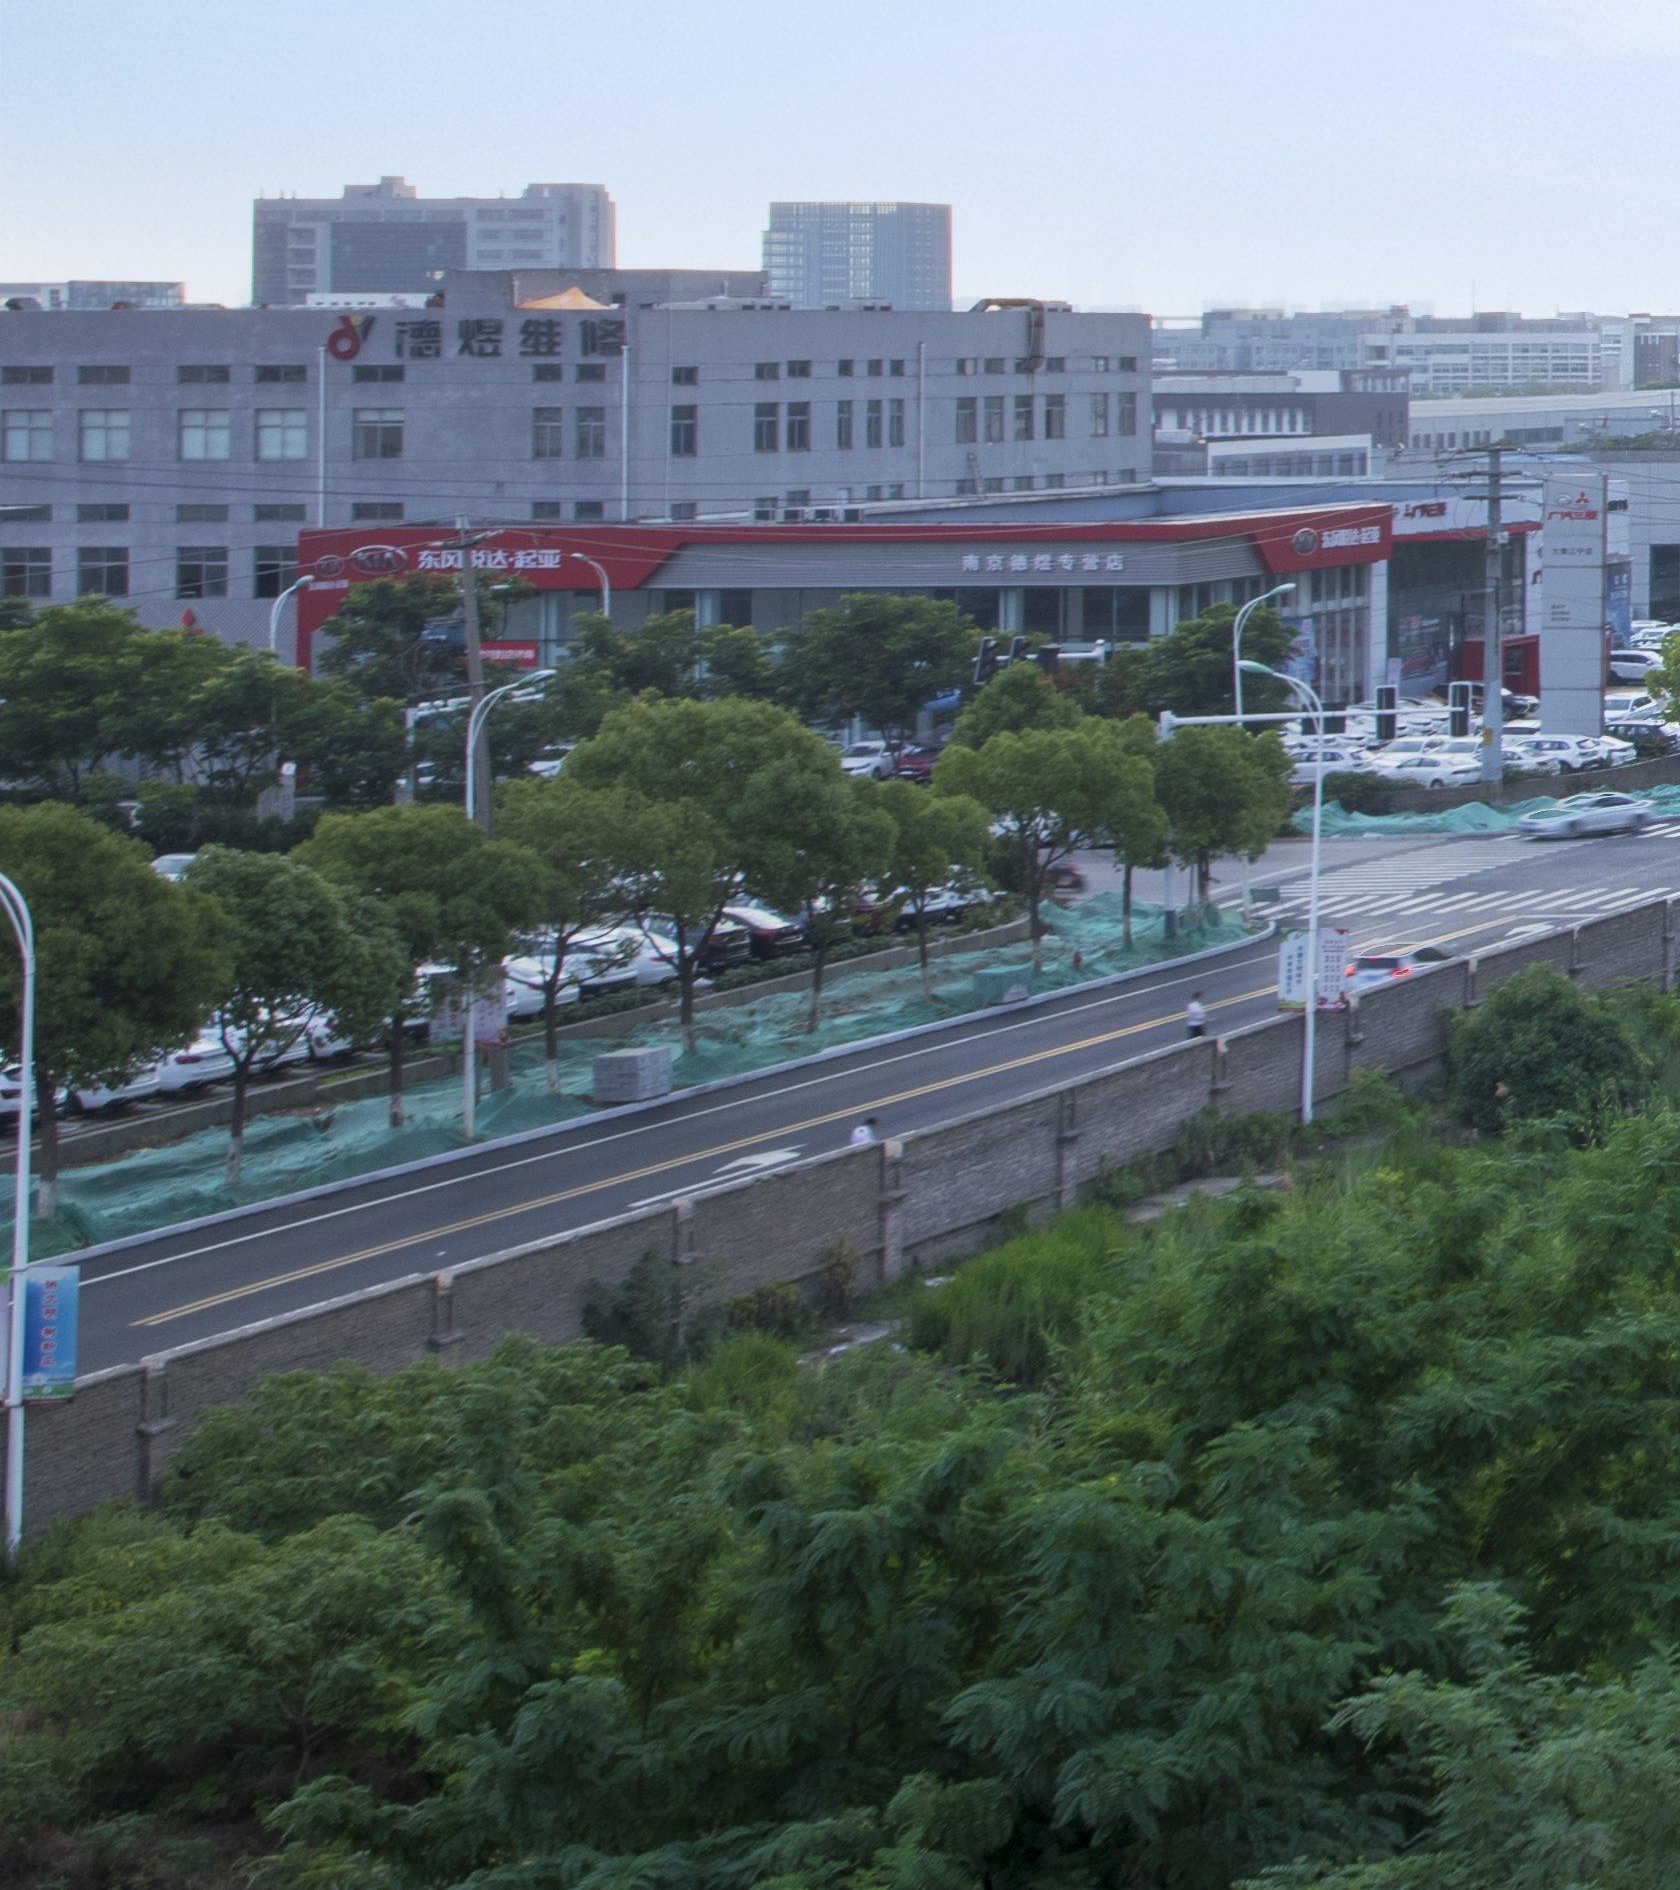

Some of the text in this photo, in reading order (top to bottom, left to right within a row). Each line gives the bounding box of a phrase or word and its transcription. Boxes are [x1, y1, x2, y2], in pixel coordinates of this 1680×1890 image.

[395, 318, 627, 358] 德煜维修
[962, 553, 1125, 571] 南京德煜专营店
